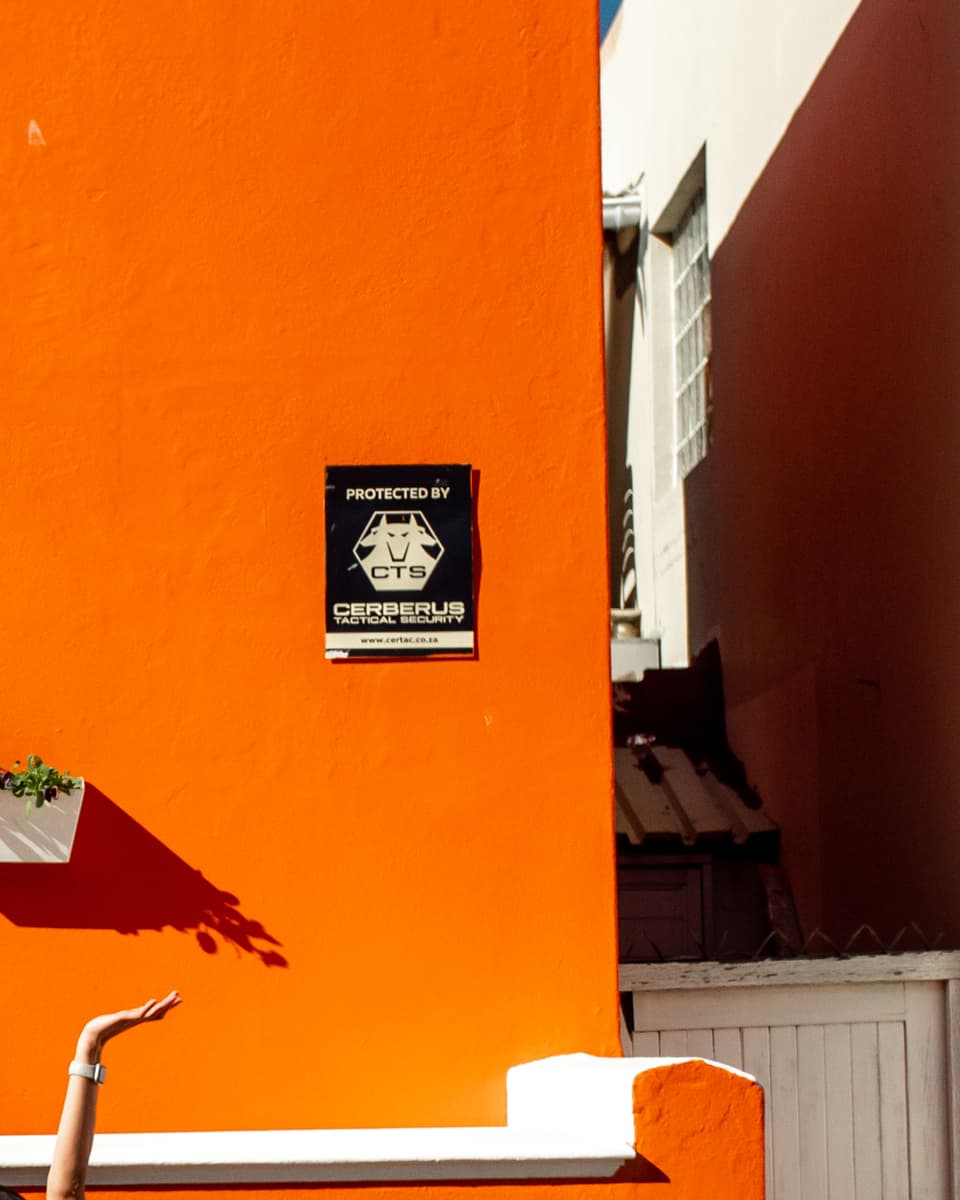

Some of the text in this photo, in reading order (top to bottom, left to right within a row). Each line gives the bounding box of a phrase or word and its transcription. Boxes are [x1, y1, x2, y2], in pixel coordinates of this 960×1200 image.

[346, 487, 450, 500] PROTECTED BY
[371, 565, 426, 579] CTS
[333, 601, 465, 616] CERBERUS
[334, 615, 465, 625] TACTICAL SECURITY
[360, 636, 439, 644] www.certac.co.za
